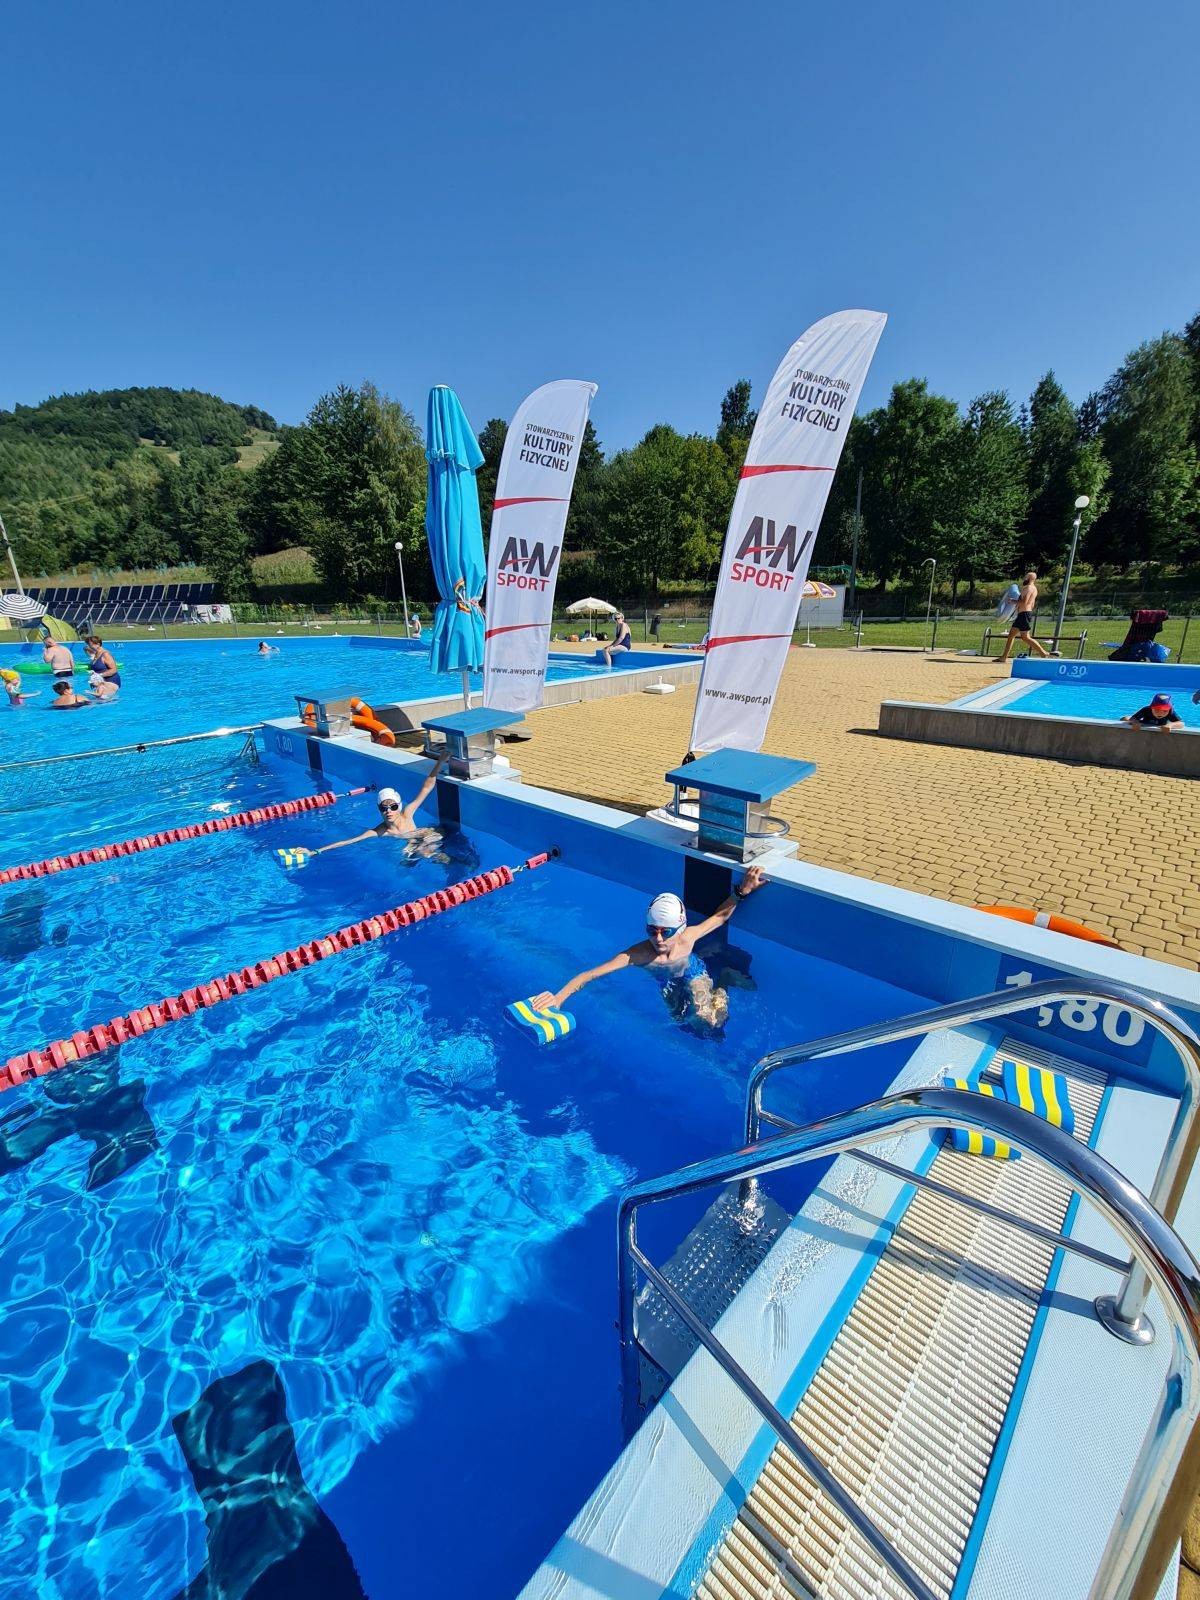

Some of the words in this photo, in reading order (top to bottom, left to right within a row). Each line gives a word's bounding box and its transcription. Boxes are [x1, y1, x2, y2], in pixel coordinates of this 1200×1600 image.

[795, 369, 851, 393] STOWARZYSZENIE
[789, 382, 847, 412] KULTURY
[781, 402, 841, 432] FIZYCZNEJ
[523, 433, 573, 457] KULTURY
[526, 424, 575, 442] STOWARZYSZENIE
[519, 449, 570, 472] FIZYCZNEJ
[735, 515, 813, 573] AW
[498, 536, 560, 577] AW
[497, 572, 550, 592] SPORT
[730, 562, 794, 592] SPORT
[705, 687, 772, 705] www.awsport.pl
